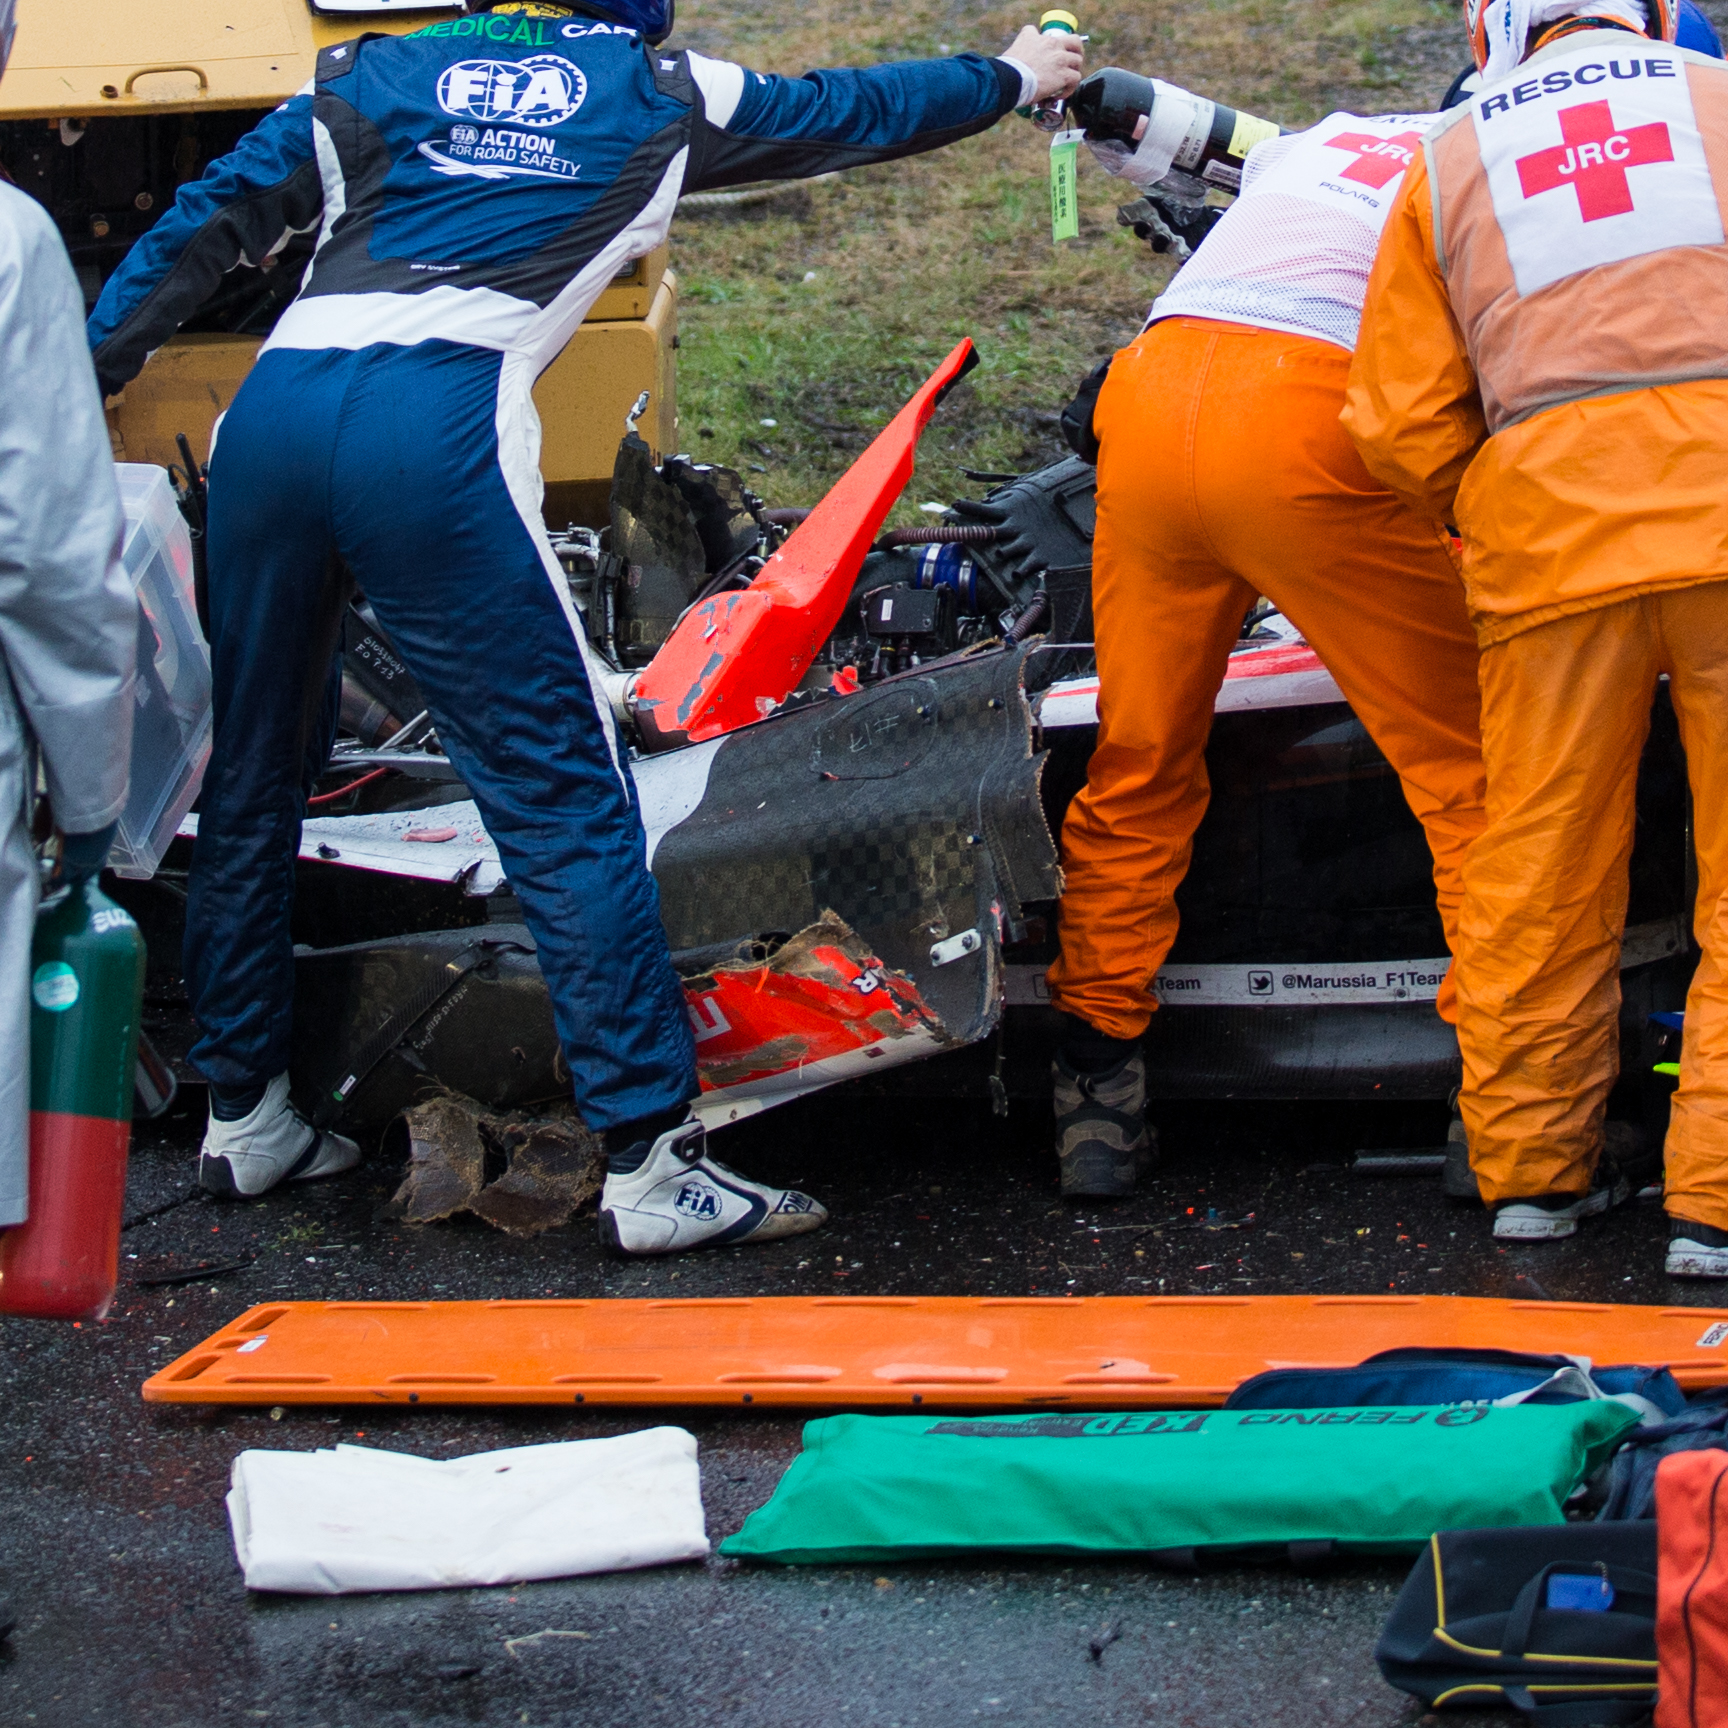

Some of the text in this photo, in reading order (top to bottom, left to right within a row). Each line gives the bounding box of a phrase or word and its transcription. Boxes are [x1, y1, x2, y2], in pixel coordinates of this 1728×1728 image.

[404, 15, 555, 47] MEDICAL
[1480, 59, 1676, 122] RESCUE
[481, 129, 556, 154] ACTION
[1557, 135, 1631, 174] JRC
[449, 144, 582, 176] FOR ROAD SAFETY
[1237, 1411, 1429, 1427] FERNO
